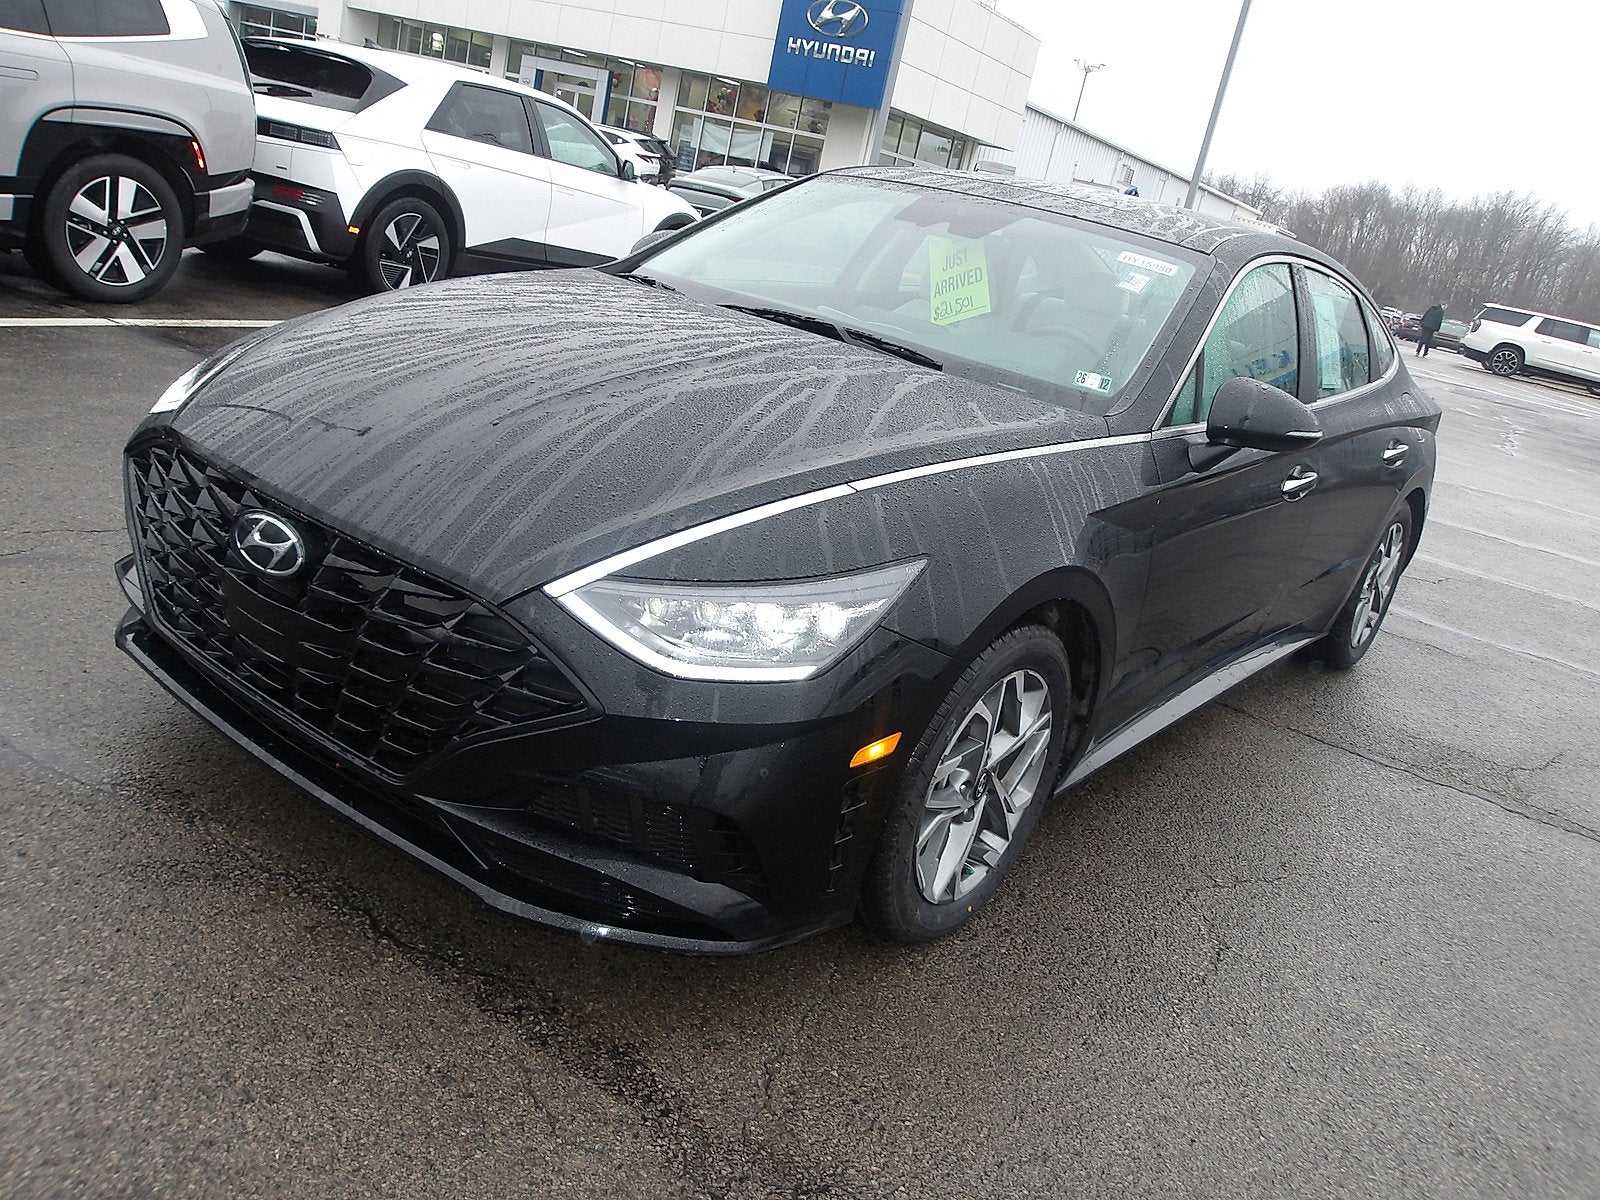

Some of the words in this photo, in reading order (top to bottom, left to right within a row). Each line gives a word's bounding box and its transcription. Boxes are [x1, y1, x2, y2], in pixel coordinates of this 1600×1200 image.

[787, 36, 876, 68] HYUNDAI
[942, 247, 968, 272] JUST
[933, 267, 983, 298] ARRIVED
[933, 295, 974, 321] $21,501
[1076, 371, 1088, 384] 26
[1099, 377, 1111, 391] 12
